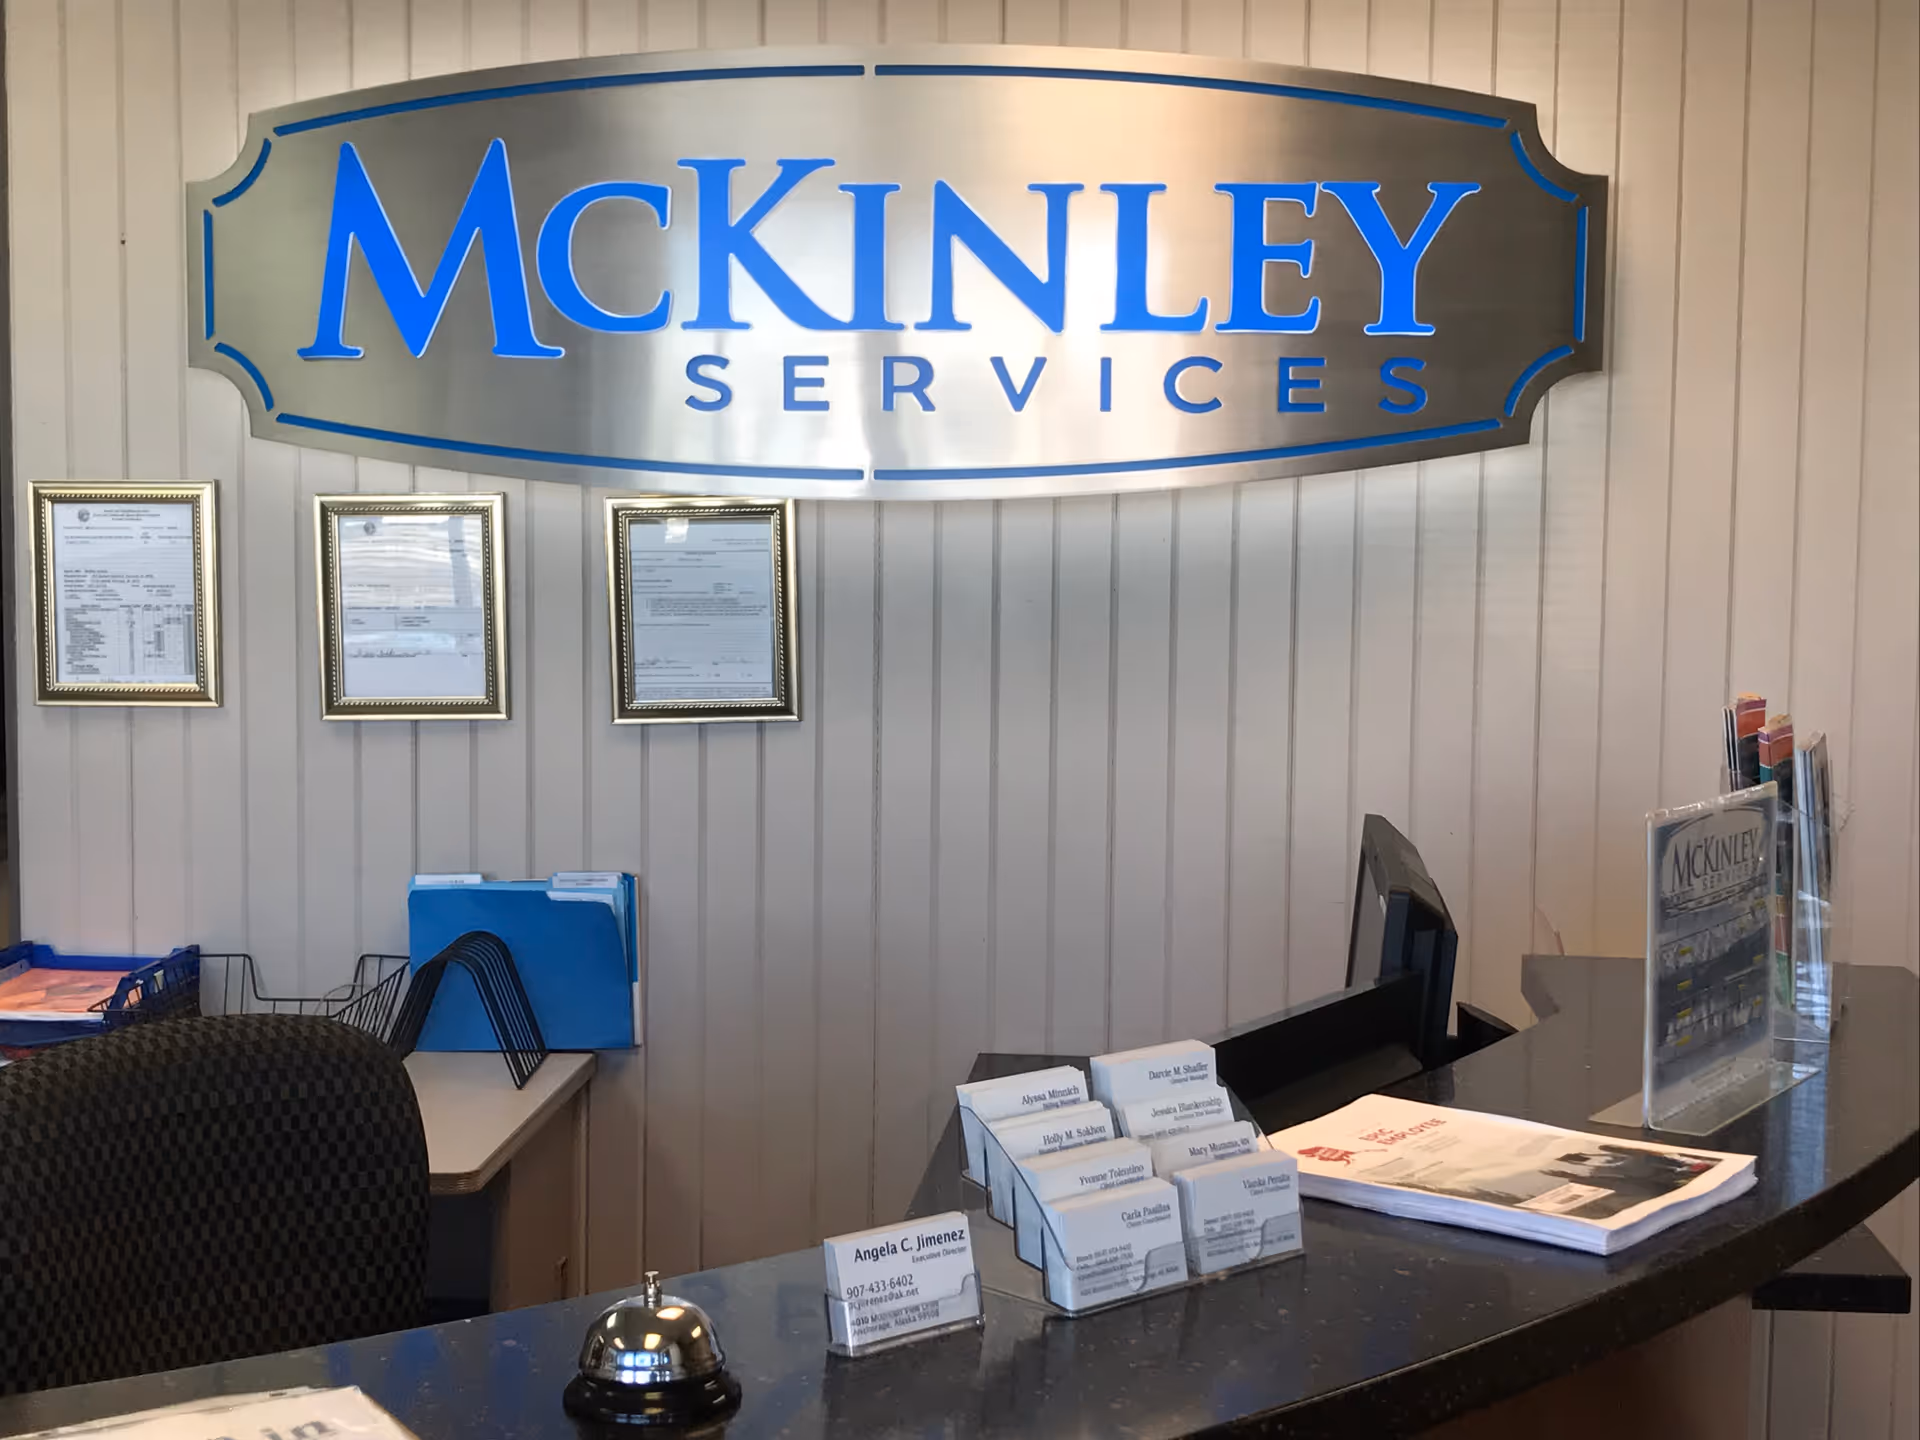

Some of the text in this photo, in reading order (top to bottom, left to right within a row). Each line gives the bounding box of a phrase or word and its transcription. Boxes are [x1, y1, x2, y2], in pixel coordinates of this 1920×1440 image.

[685, 353, 1429, 415] SERVICES
[1021, 1085, 1080, 1105] Alyssa Minnich
[1043, 1134, 1064, 1146] Holly
[1188, 1146, 1208, 1157] Mary
[1108, 1164, 1144, 1179] Tolentino
[1121, 1210, 1142, 1222] Carla
[854, 1229, 966, 1263] Angela C. Jimenez
[911, 1245, 967, 1263] Executive Director
[846, 1273, 914, 1299] 907-433-6402
